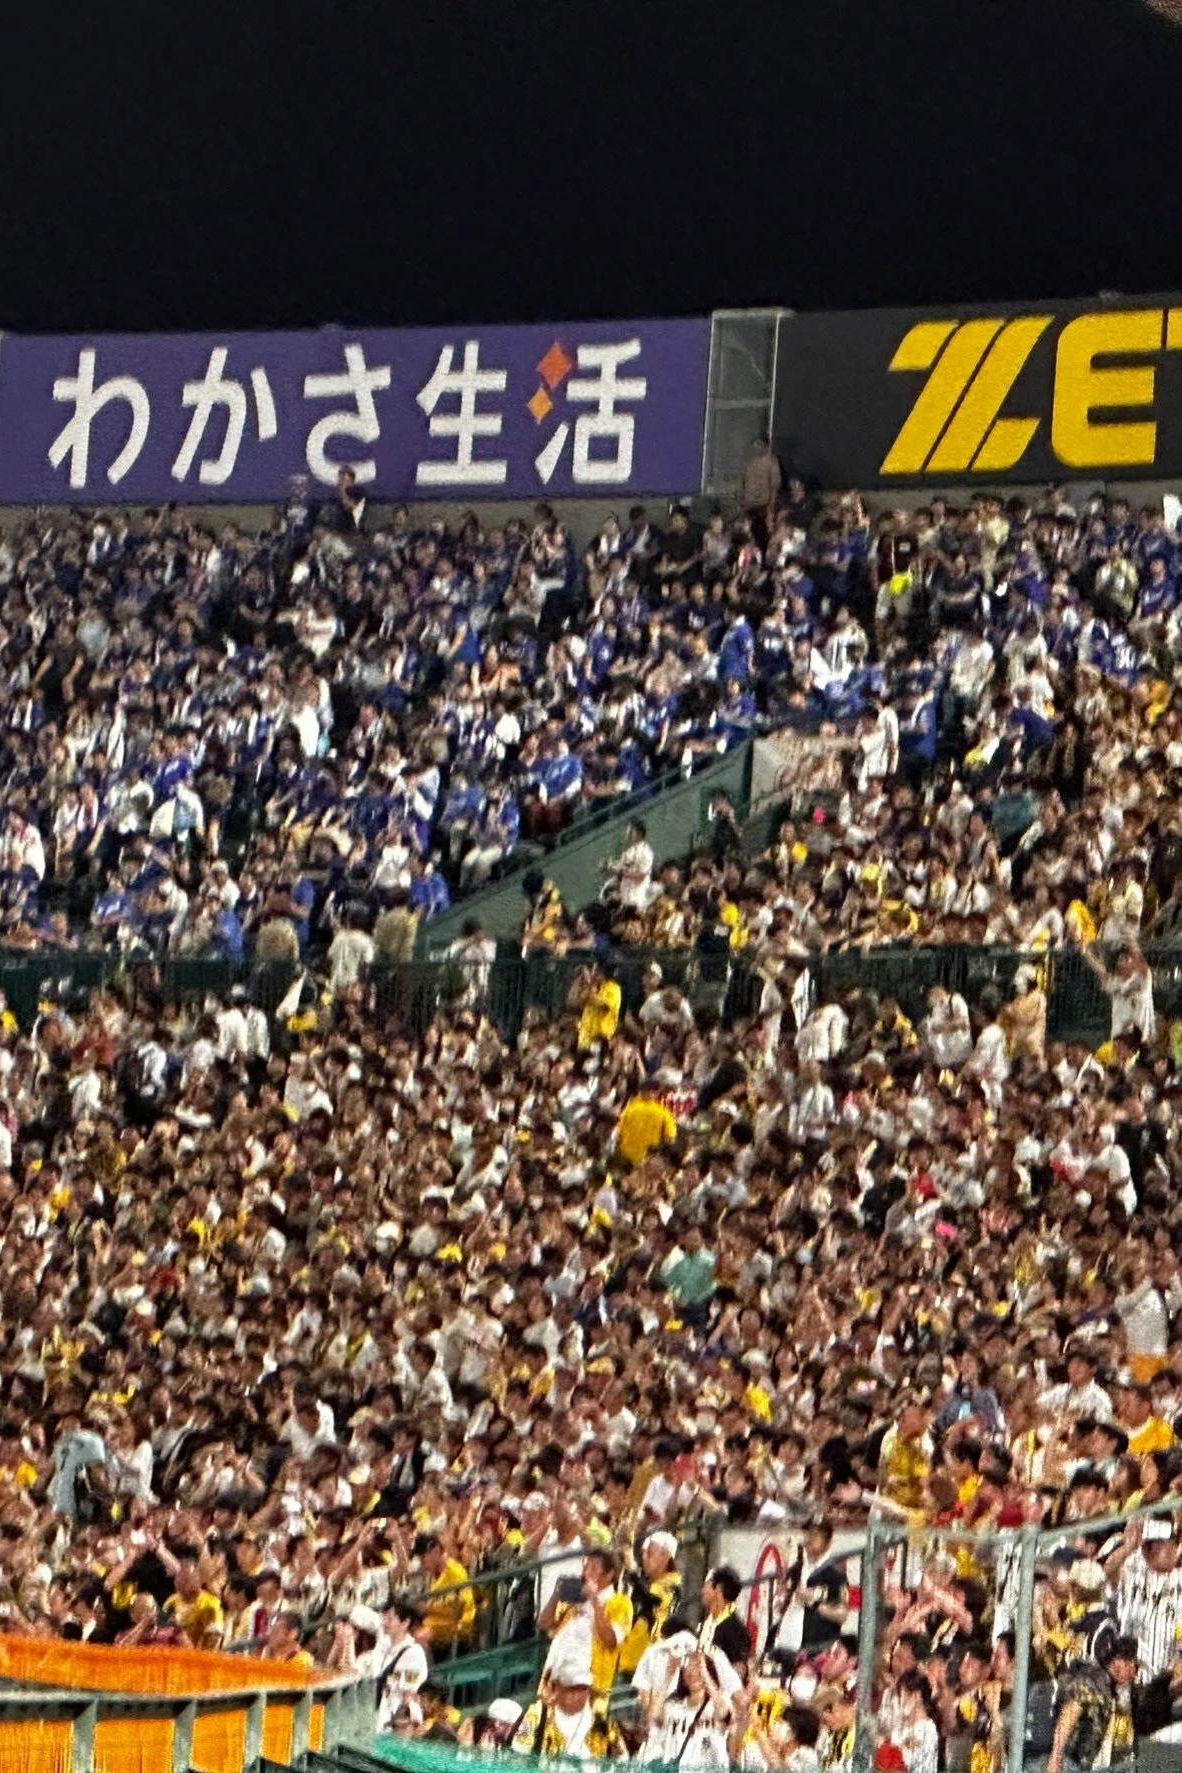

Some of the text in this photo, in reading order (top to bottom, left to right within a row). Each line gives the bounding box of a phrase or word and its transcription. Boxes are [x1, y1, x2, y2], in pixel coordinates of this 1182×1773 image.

[47, 338, 648, 489] わかさ生活
[880, 307, 1182, 475] ZE
